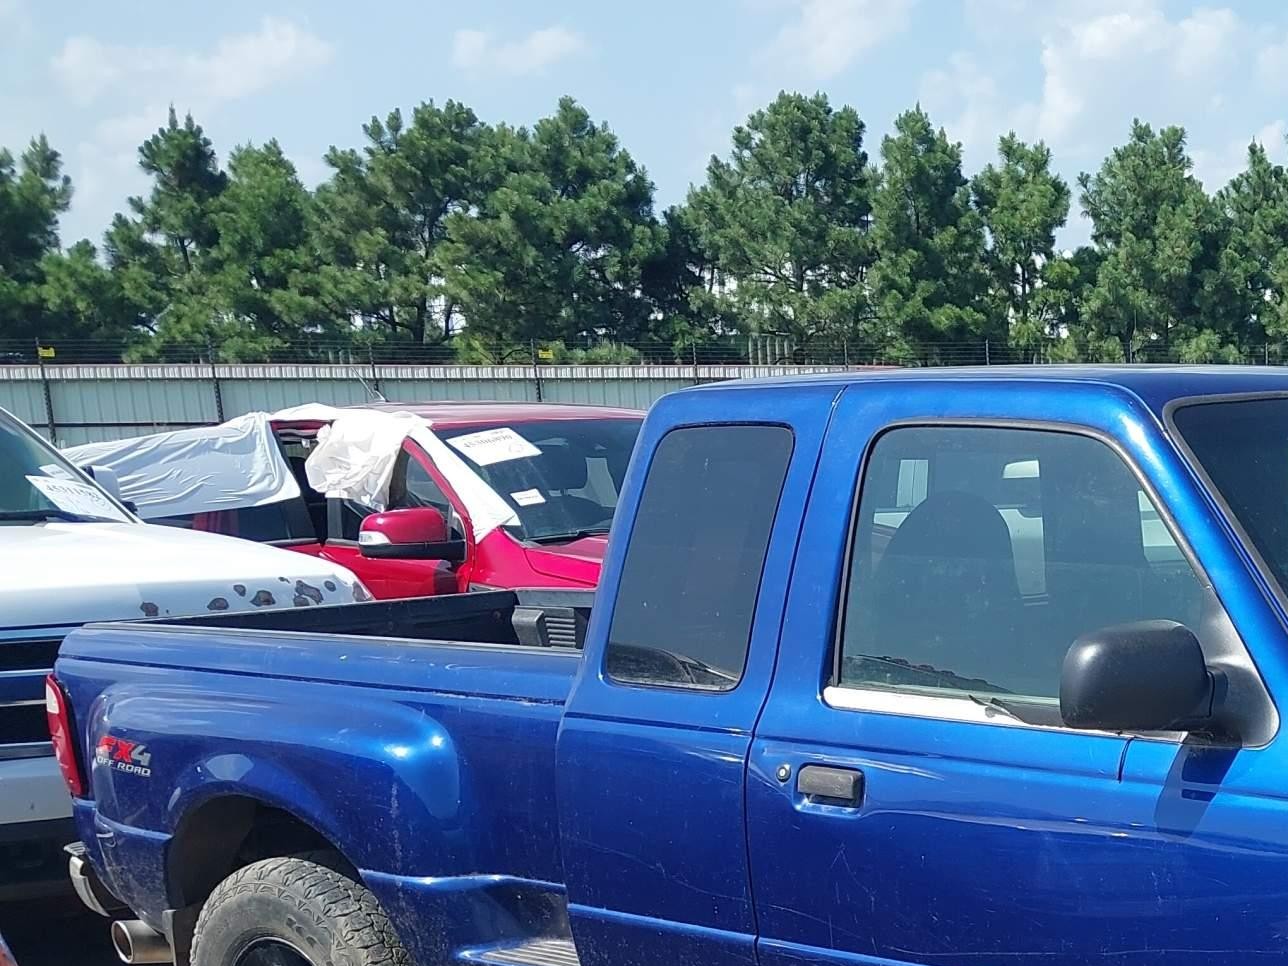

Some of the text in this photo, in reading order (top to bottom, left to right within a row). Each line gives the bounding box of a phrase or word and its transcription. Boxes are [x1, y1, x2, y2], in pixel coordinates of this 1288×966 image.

[95, 735, 152, 767] FX4
[96, 755, 151, 777] OFF ROAD
